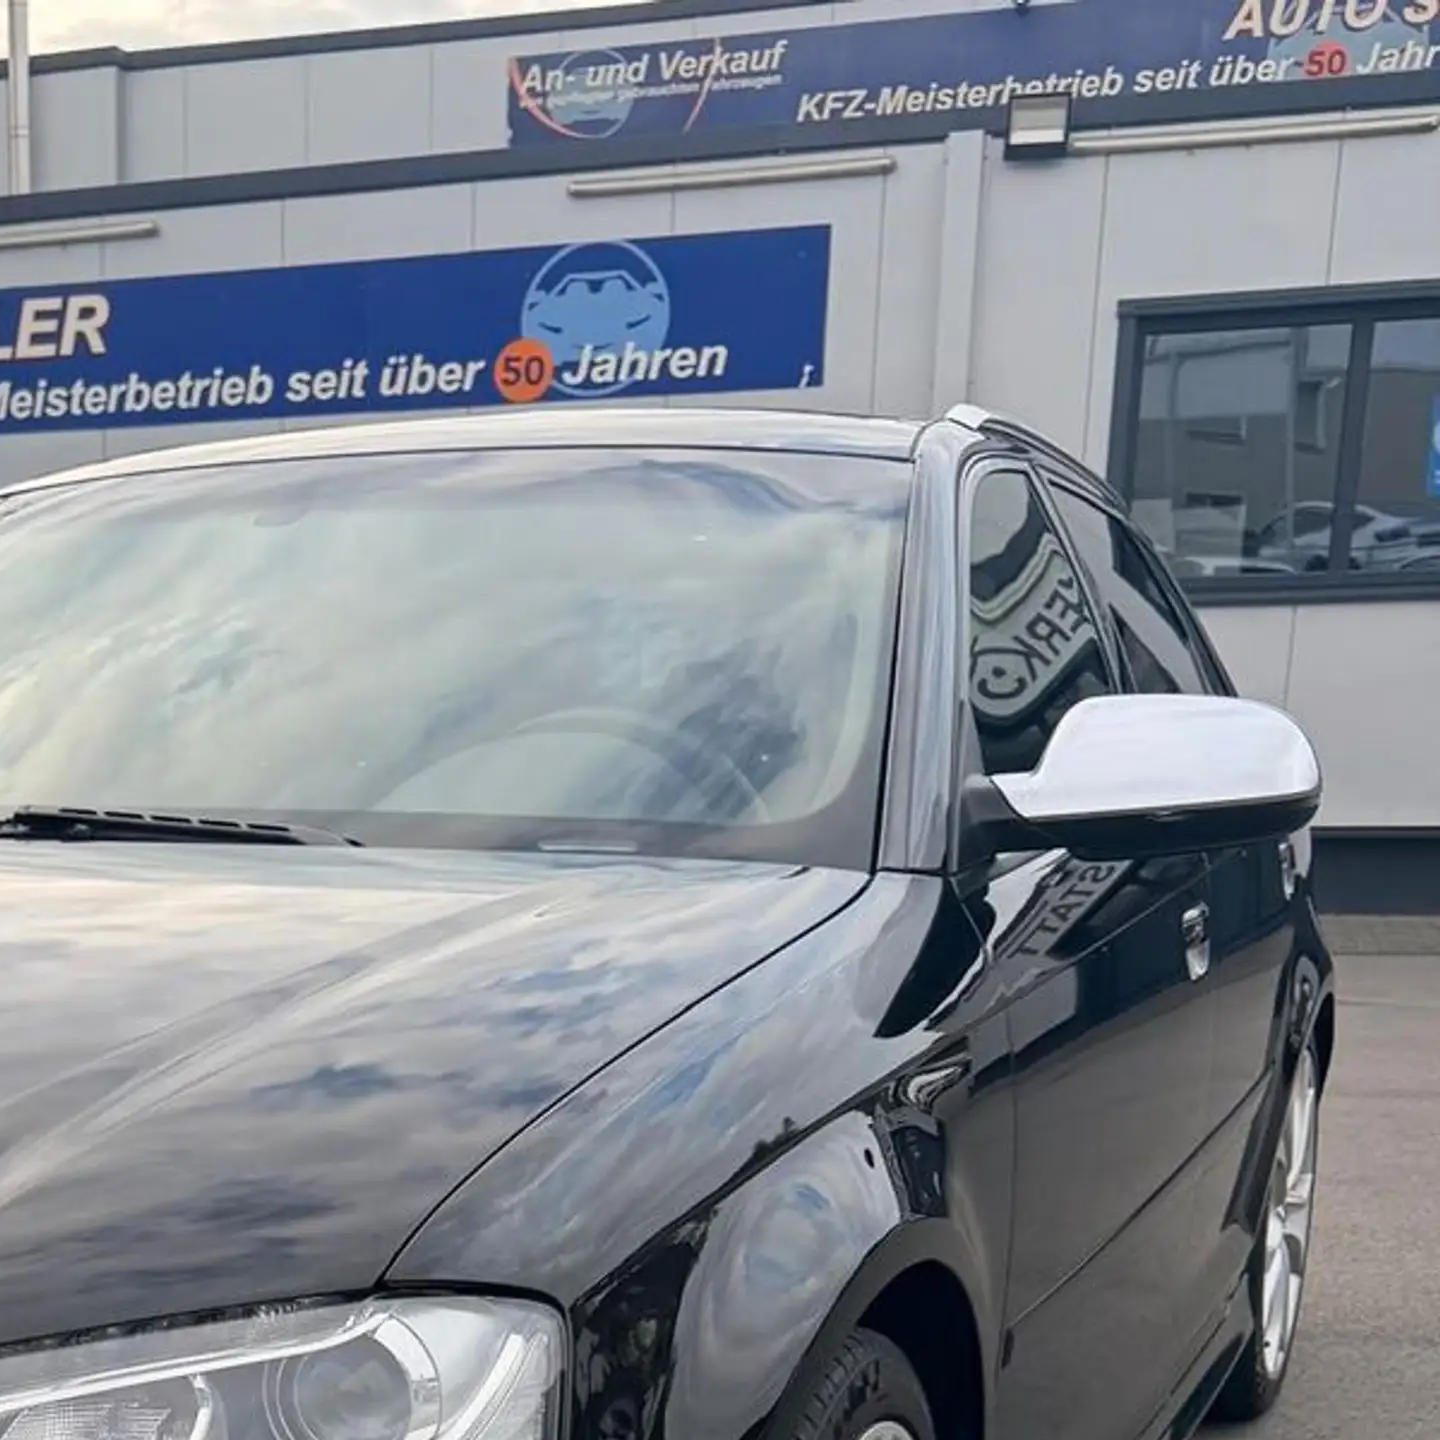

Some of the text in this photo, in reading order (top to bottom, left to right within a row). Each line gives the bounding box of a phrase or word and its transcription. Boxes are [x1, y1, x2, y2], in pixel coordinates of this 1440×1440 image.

[523, 39, 789, 94] An- und Verkauf
[1132, 59, 1203, 93] seit
[1209, 54, 1295, 87] über
[1304, 48, 1347, 77] 50
[284, 357, 370, 401] seit
[379, 354, 486, 398] über
[501, 354, 545, 387] 50
[561, 341, 729, 386] Jahren
